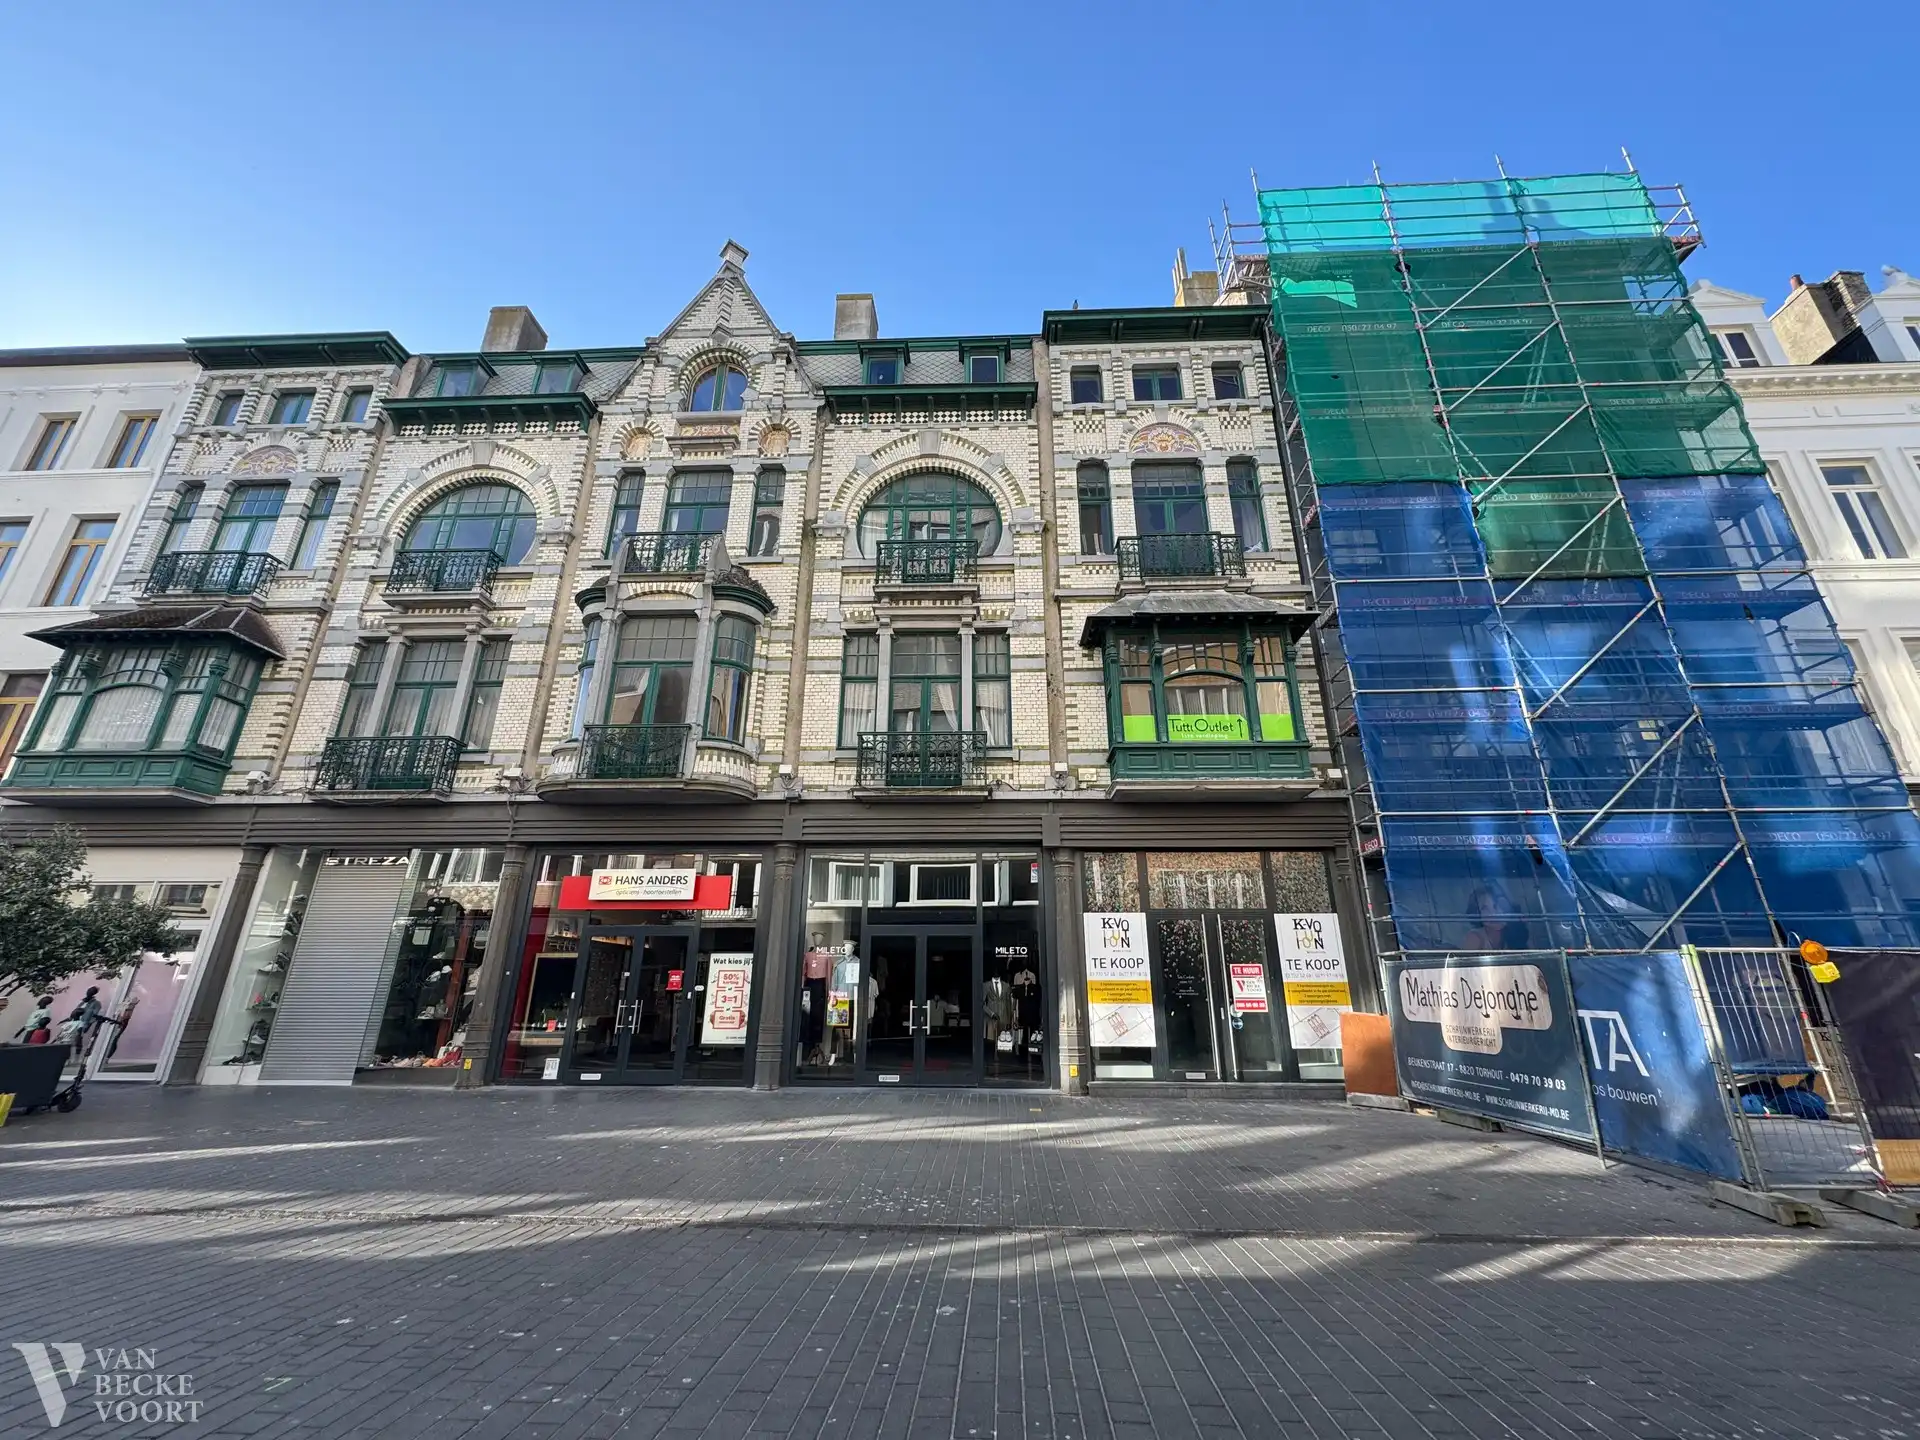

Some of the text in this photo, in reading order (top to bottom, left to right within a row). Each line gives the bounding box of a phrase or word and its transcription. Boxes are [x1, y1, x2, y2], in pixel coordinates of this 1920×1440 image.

[1386, 709, 1413, 719] DECO
[1195, 718, 1234, 732] Outlet
[1769, 831, 1801, 841] DECO
[1364, 838, 1379, 850] DECO
[615, 875, 688, 885] HANS ANDERS
[816, 946, 848, 955] MILETO
[995, 946, 1028, 955] MILETO
[728, 957, 743, 965] kies
[1091, 957, 1144, 969] TE KOOP
[1285, 959, 1340, 971] TE KOOP
[723, 973, 739, 981] 50%
[721, 995, 738, 1003] 3=1
[1405, 977, 1539, 1021] Mathias Dejonghe
[1407, 1056, 1567, 1091] BEUKENSTRAAT 17 8820 TORHOUT 0479 70 39 03
[1607, 1083, 1658, 1106] bouwen
